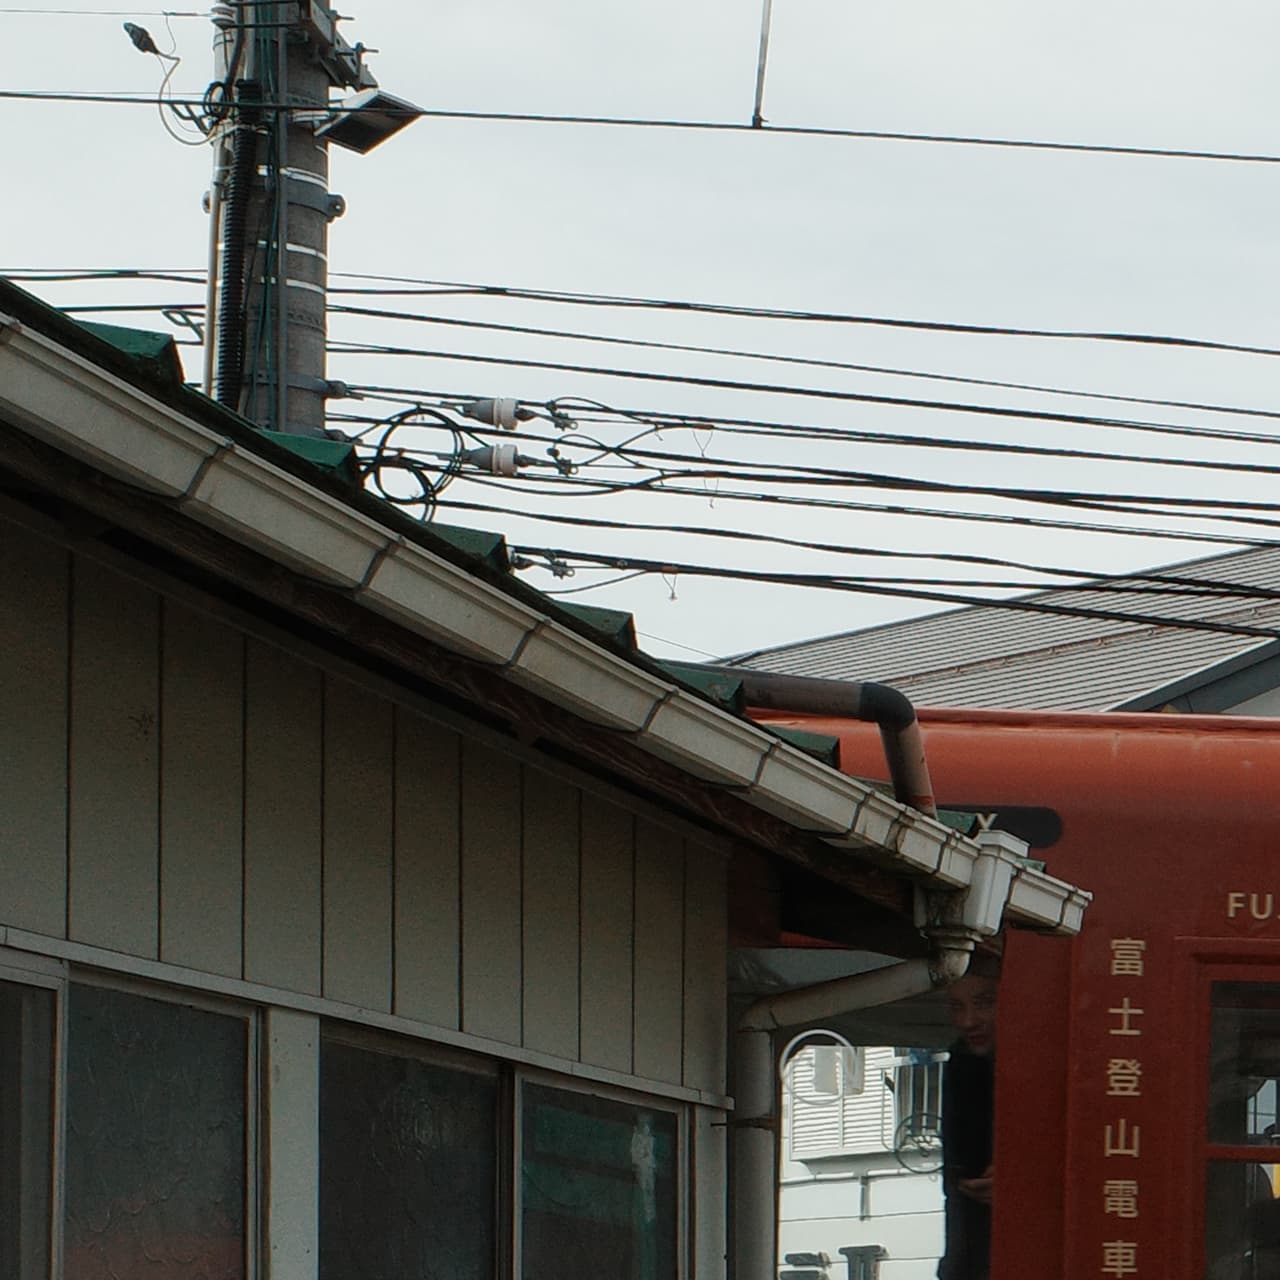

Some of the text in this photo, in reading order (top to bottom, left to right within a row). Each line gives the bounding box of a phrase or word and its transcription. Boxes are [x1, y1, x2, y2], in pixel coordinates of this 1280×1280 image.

[1101, 937, 1146, 1278] 富士登山電車
